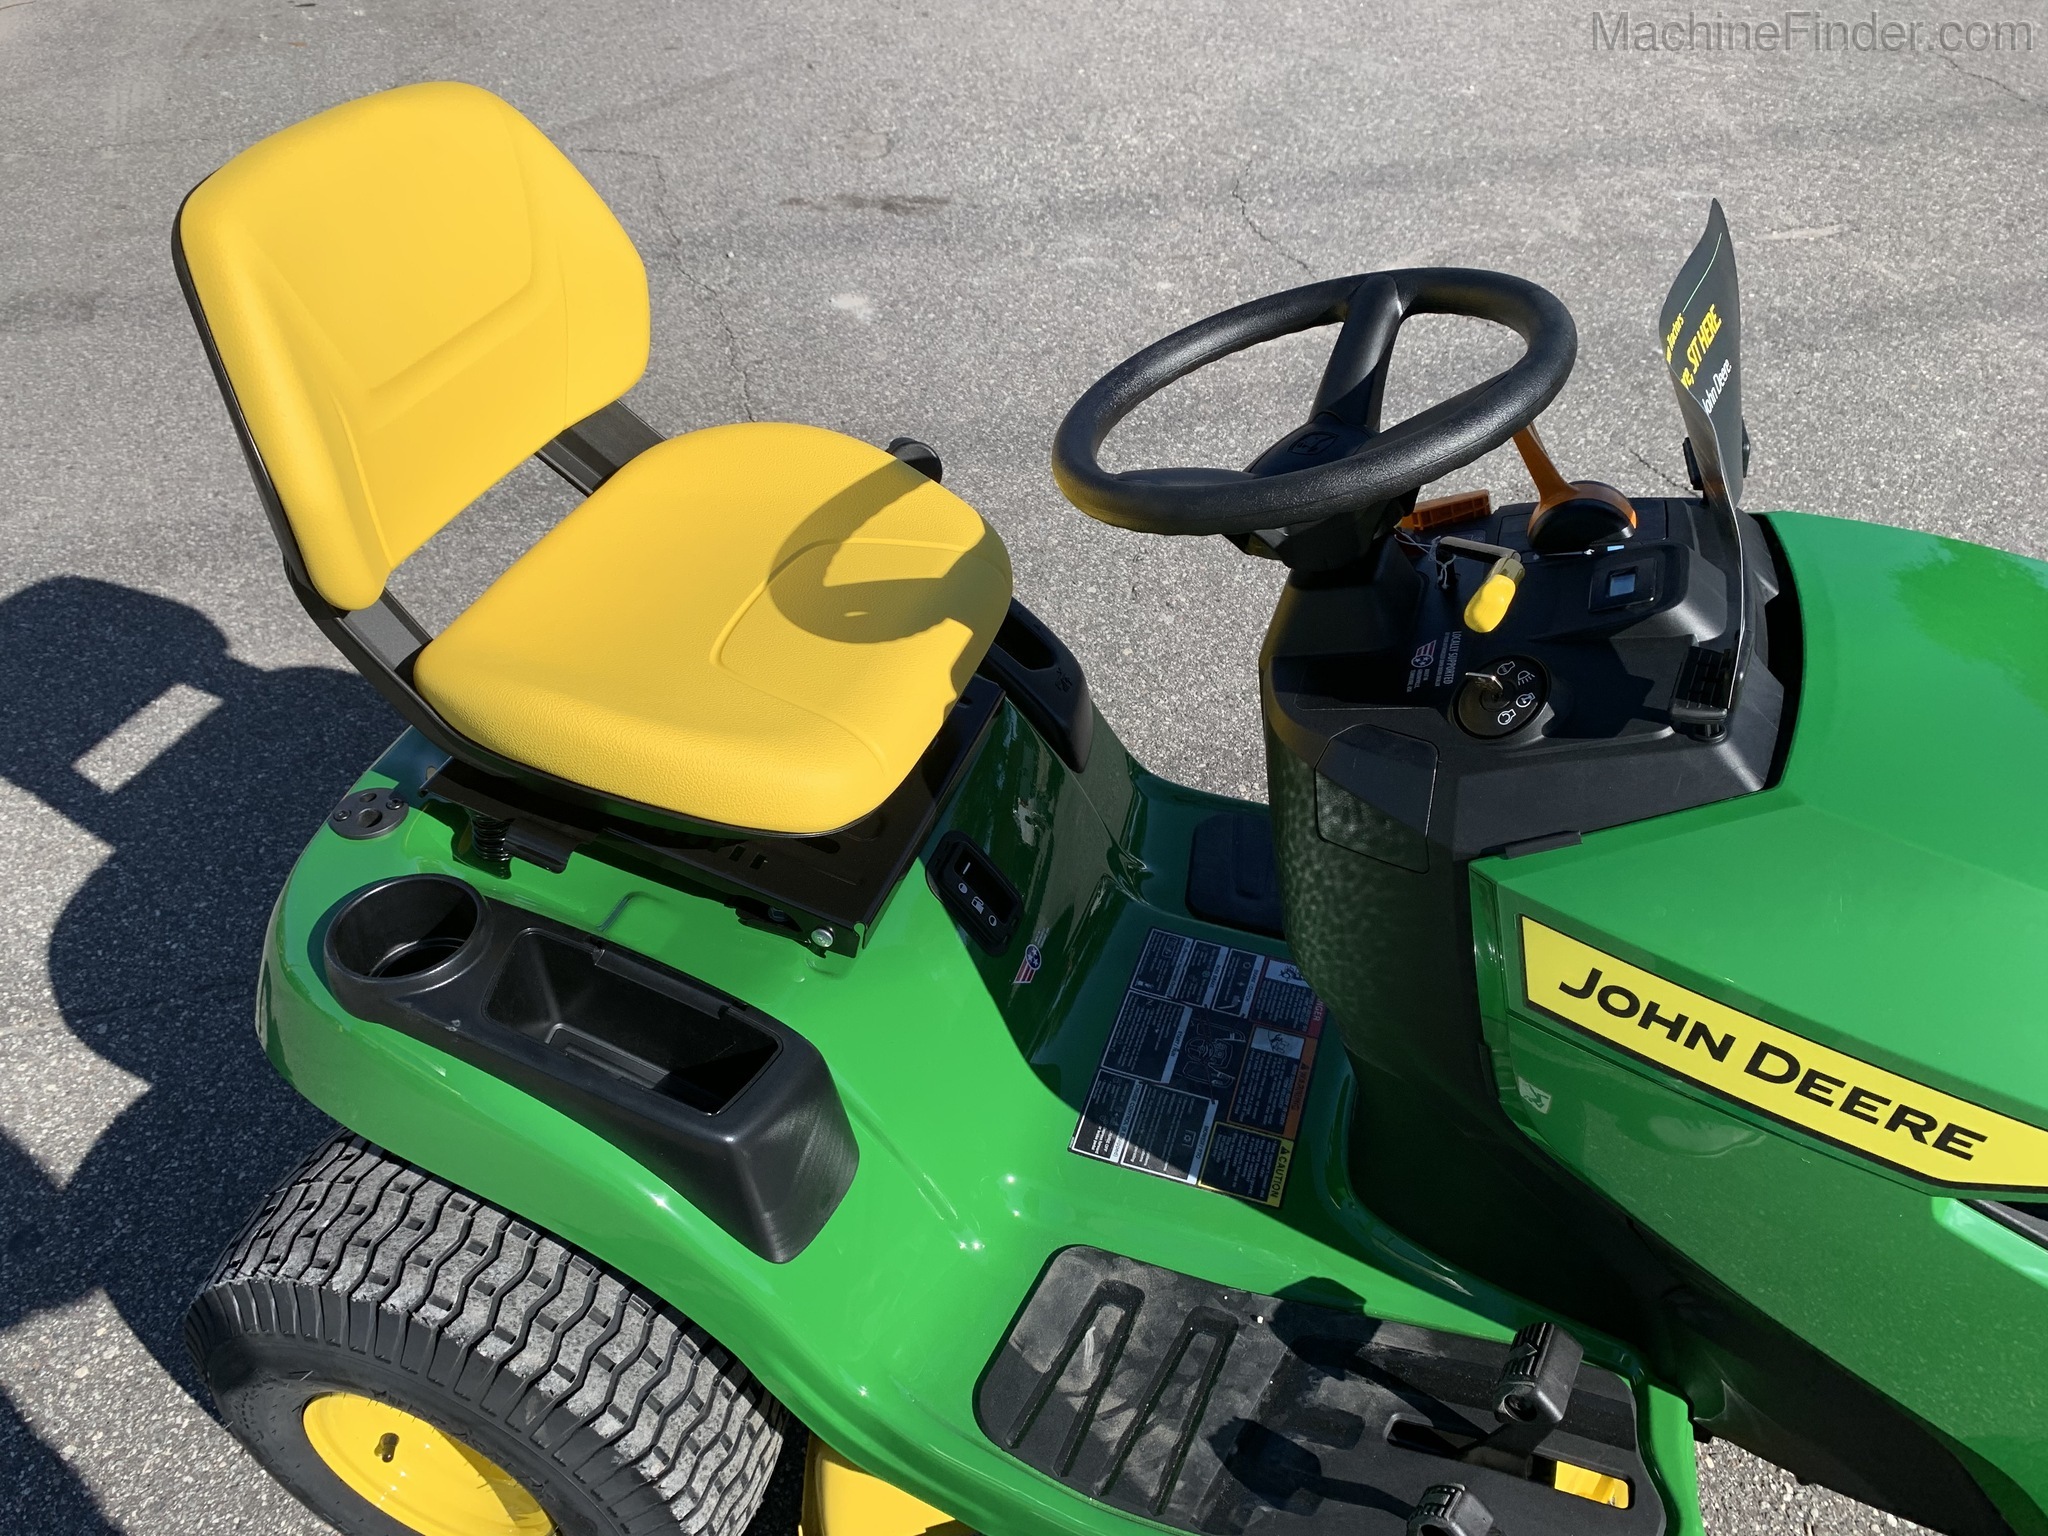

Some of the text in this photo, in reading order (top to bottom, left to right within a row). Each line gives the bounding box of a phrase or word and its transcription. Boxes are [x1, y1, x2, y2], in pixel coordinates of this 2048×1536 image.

[1687, 336, 1702, 375] SIT
[1443, 631, 1462, 685] LOCALLY SUPPORTED
[1313, 1000, 1324, 1021] NGER
[1558, 967, 1988, 1161] JOHN DEERE
[1123, 1102, 1134, 1126] CONTROL
[1270, 1156, 1287, 1198] CAUTION
